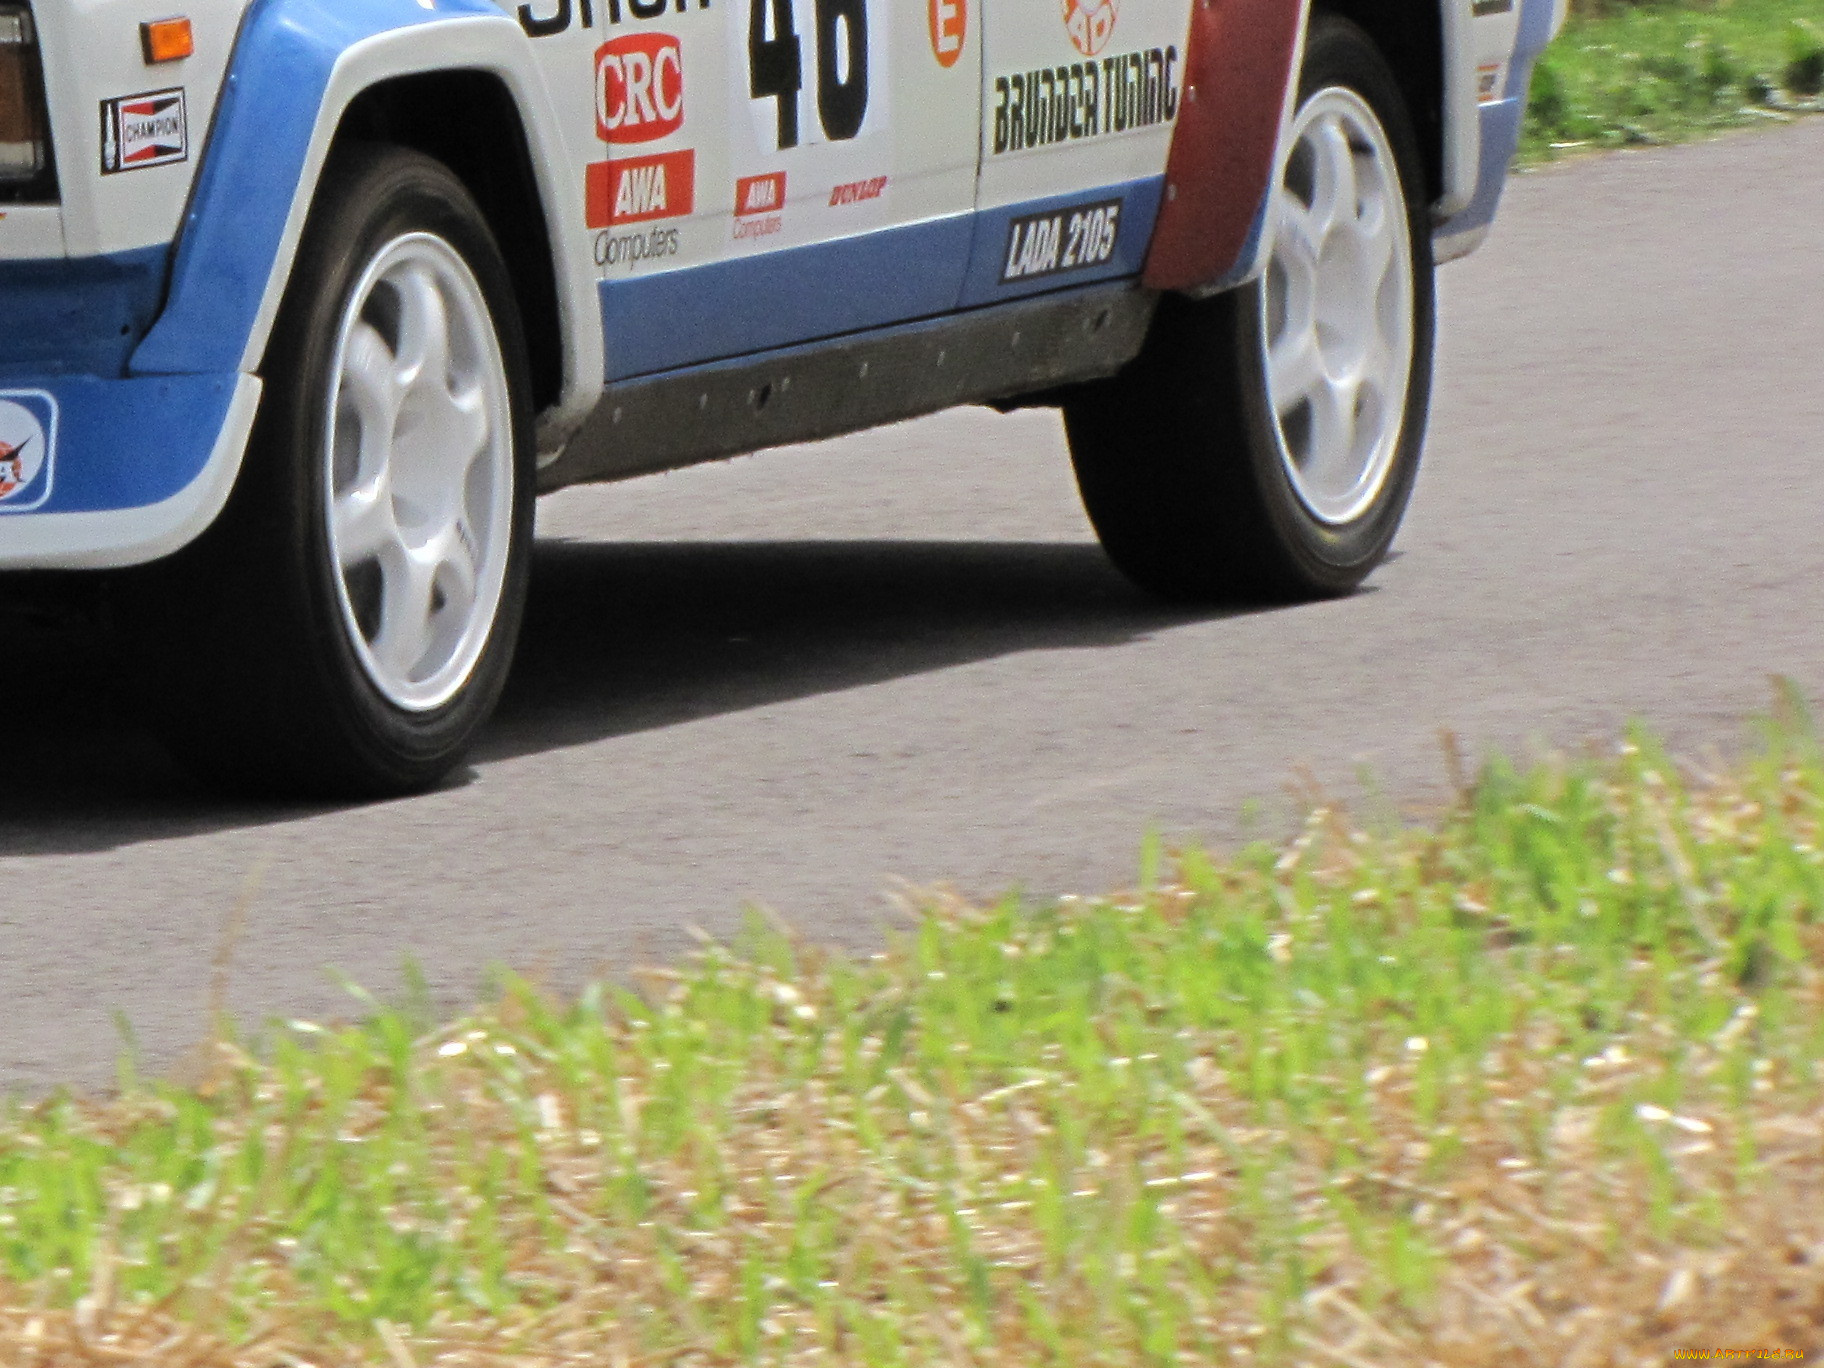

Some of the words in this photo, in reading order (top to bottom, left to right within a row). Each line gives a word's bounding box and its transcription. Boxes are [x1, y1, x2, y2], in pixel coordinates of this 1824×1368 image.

[596, 46, 682, 130] CRC
[993, 60, 1100, 155] BRUNDER
[1103, 45, 1177, 133] TUNING
[614, 164, 668, 218] AWA
[594, 226, 679, 271] Computers
[1004, 215, 1063, 279] LADA
[1061, 205, 1120, 268] 2105
